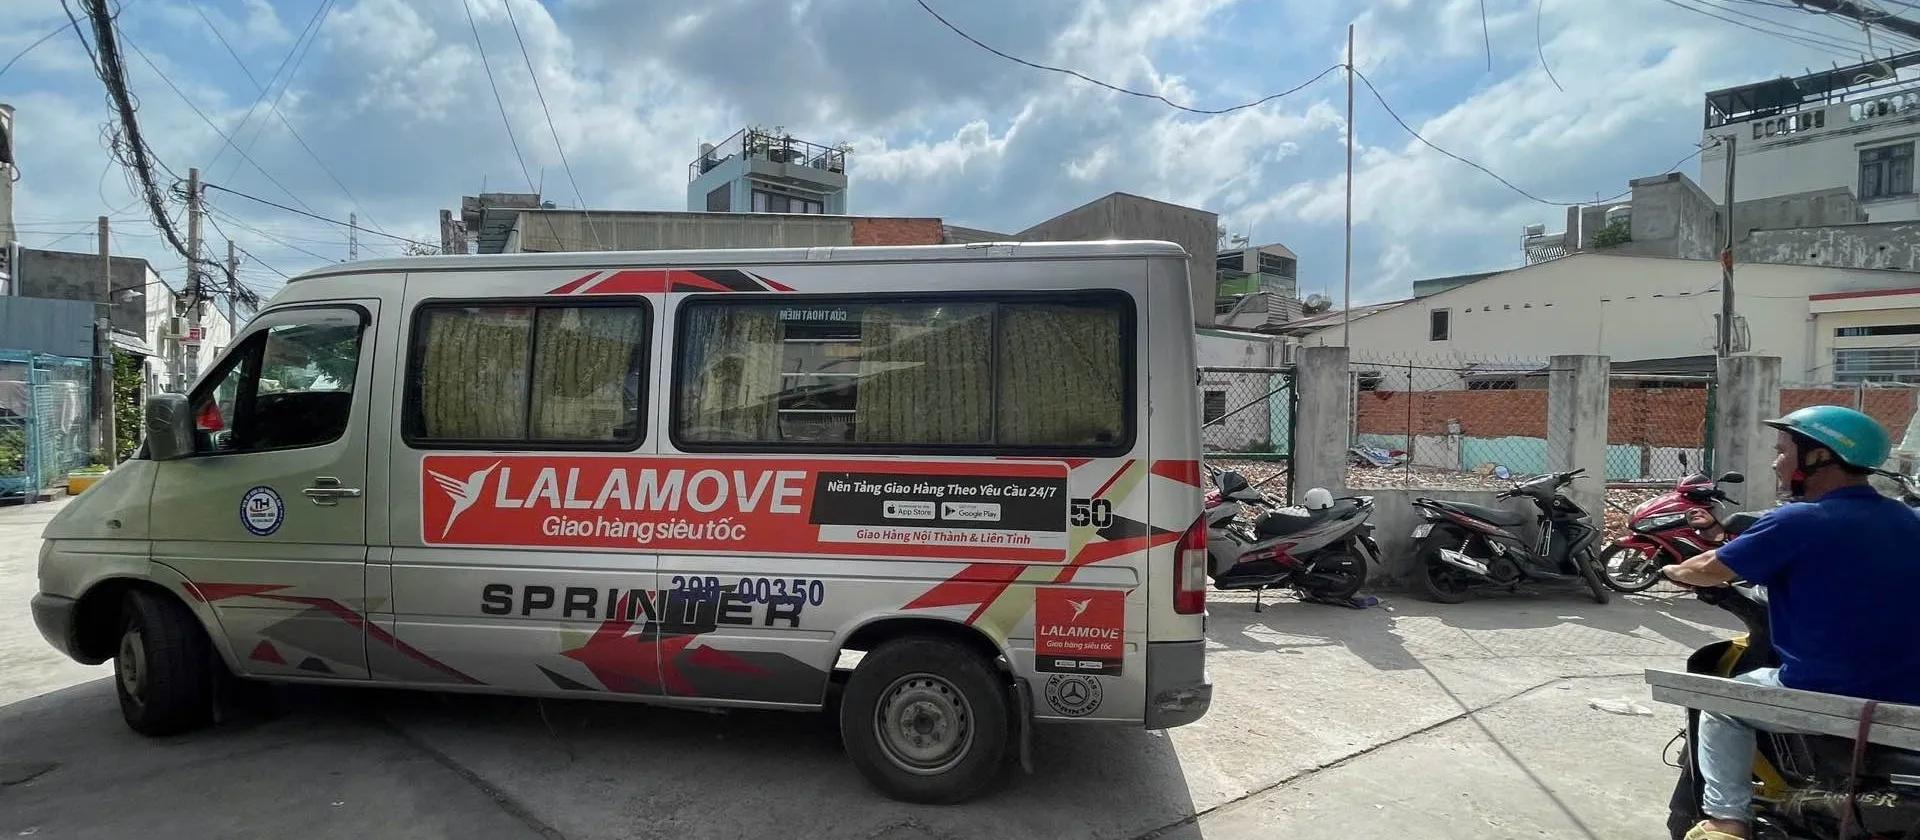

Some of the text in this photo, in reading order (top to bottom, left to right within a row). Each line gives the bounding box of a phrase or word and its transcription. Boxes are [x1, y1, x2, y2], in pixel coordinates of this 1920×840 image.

[494, 466, 808, 513] LALAMOVE
[827, 479, 1057, 500] Nền Tảng Giao Hàng Theo Yêu Cầu 24/7
[898, 508, 931, 516] App Store
[958, 509, 997, 518] Google Play
[542, 515, 747, 544] Giao hàng siêu tốc
[856, 528, 1031, 545] Giao Hàng Nội Thành & Liên Tỉnh
[481, 582, 804, 628] SPRINTER
[1040, 625, 1120, 639] LALAMOVE
[1046, 640, 1063, 648] Giao
[1083, 641, 1100, 649] siêu
[1100, 642, 1113, 650] tốc
